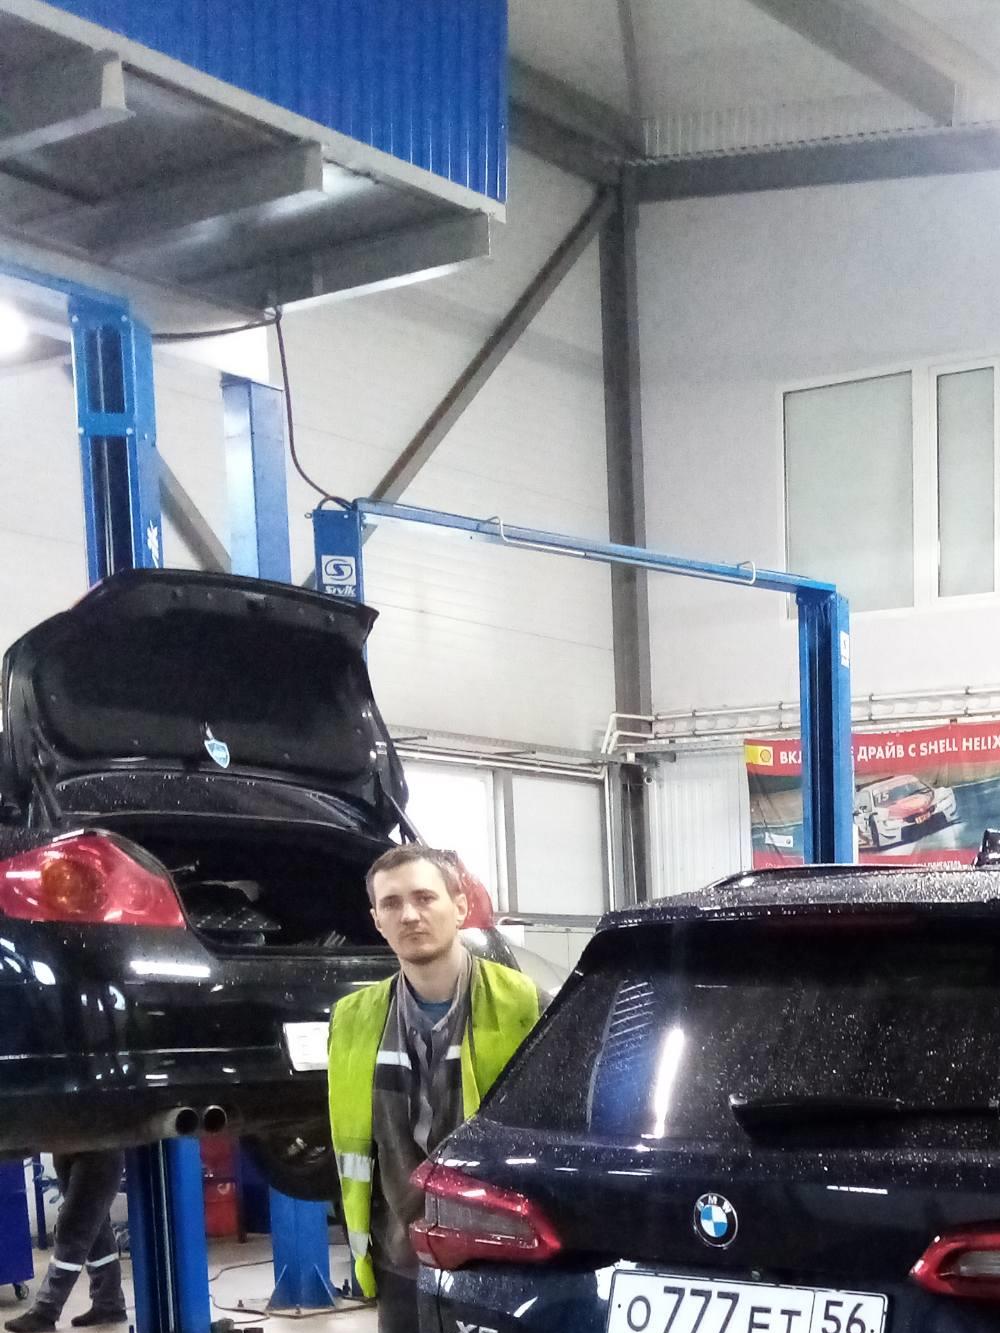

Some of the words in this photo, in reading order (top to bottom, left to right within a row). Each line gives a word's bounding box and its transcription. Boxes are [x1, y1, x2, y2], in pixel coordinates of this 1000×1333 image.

[857, 742, 905, 762] ДРАЙВ
[908, 744, 916, 758] С
[919, 738, 959, 757] SHELL
[696, 1194, 732, 1213] BMW
